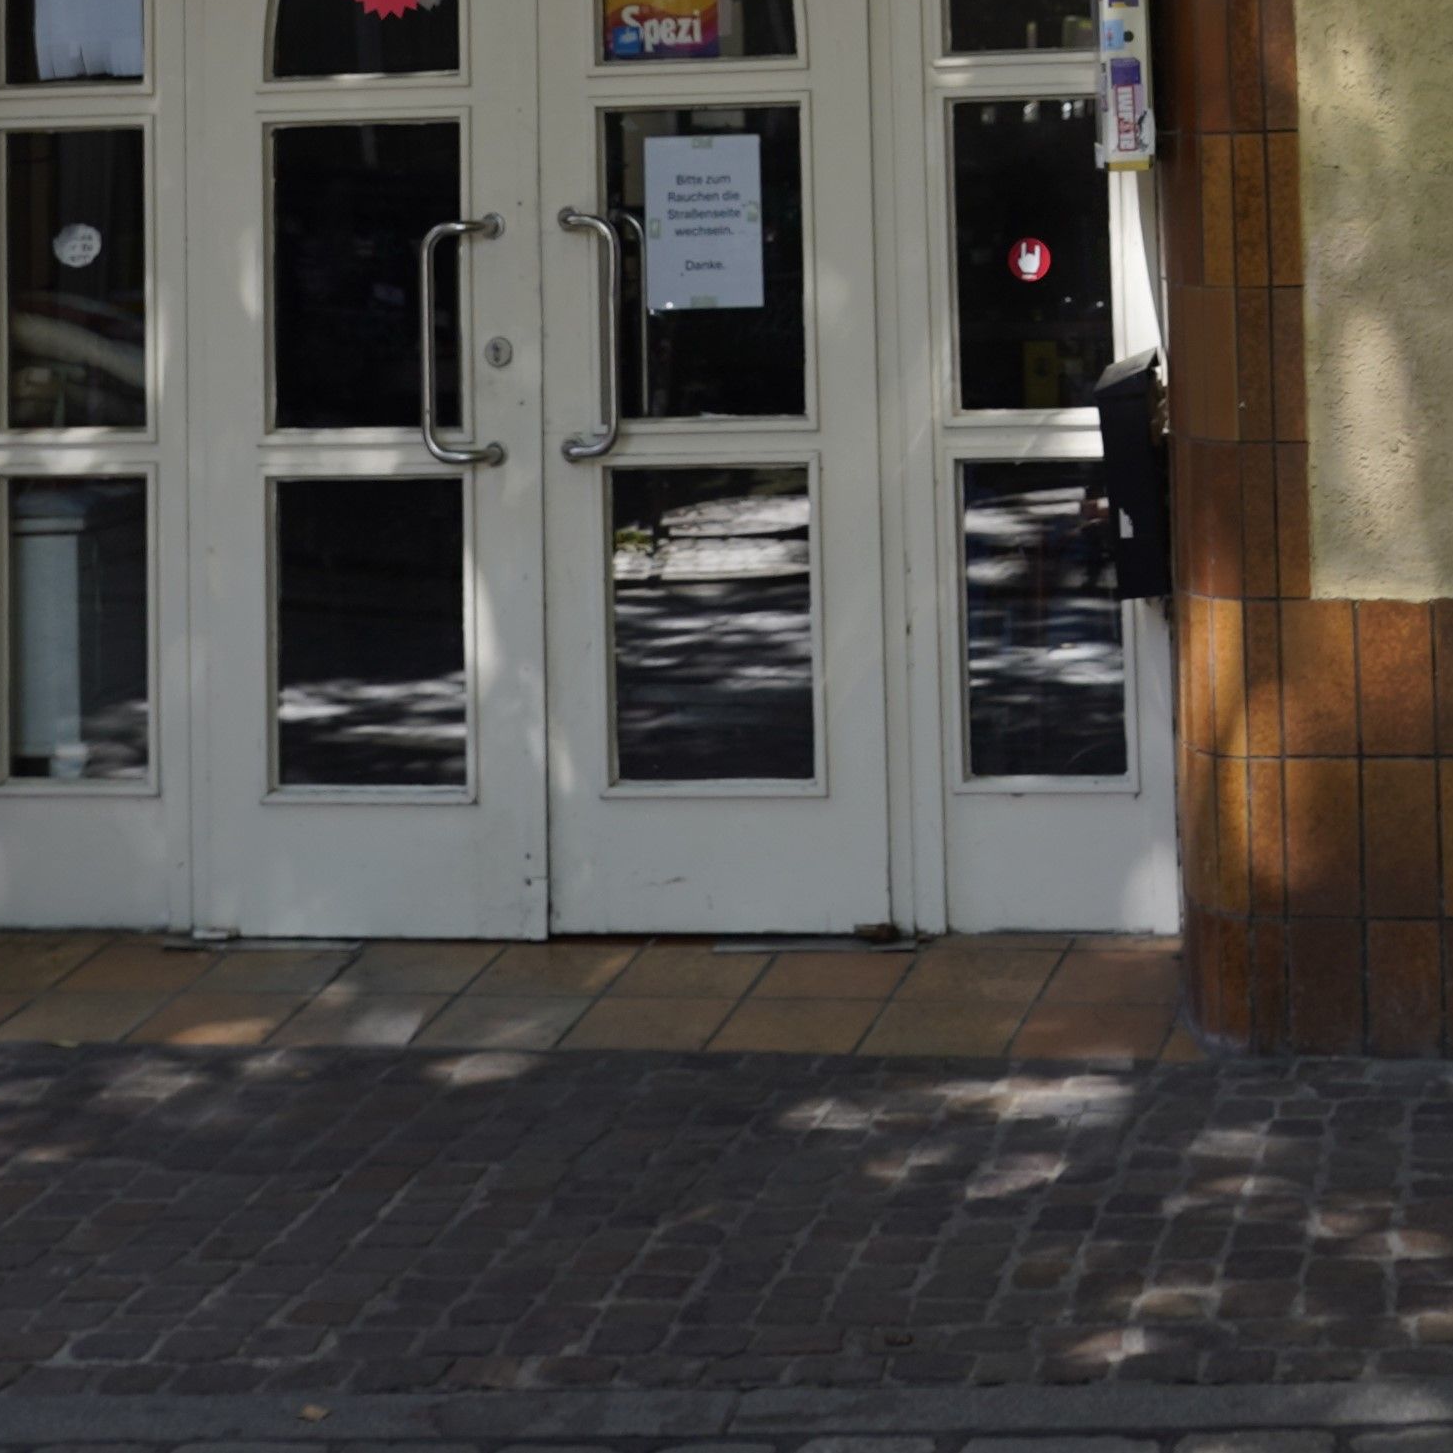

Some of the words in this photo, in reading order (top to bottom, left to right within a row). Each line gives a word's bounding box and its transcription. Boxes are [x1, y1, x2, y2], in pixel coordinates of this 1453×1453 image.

[621, 4, 702, 52] Spezi
[675, 174, 704, 186] Bitte
[705, 175, 732, 185] zum
[667, 191, 720, 203] Rauchen
[722, 190, 741, 202] die
[667, 208, 742, 221] Straßenseite
[684, 259, 726, 271] Danke.
